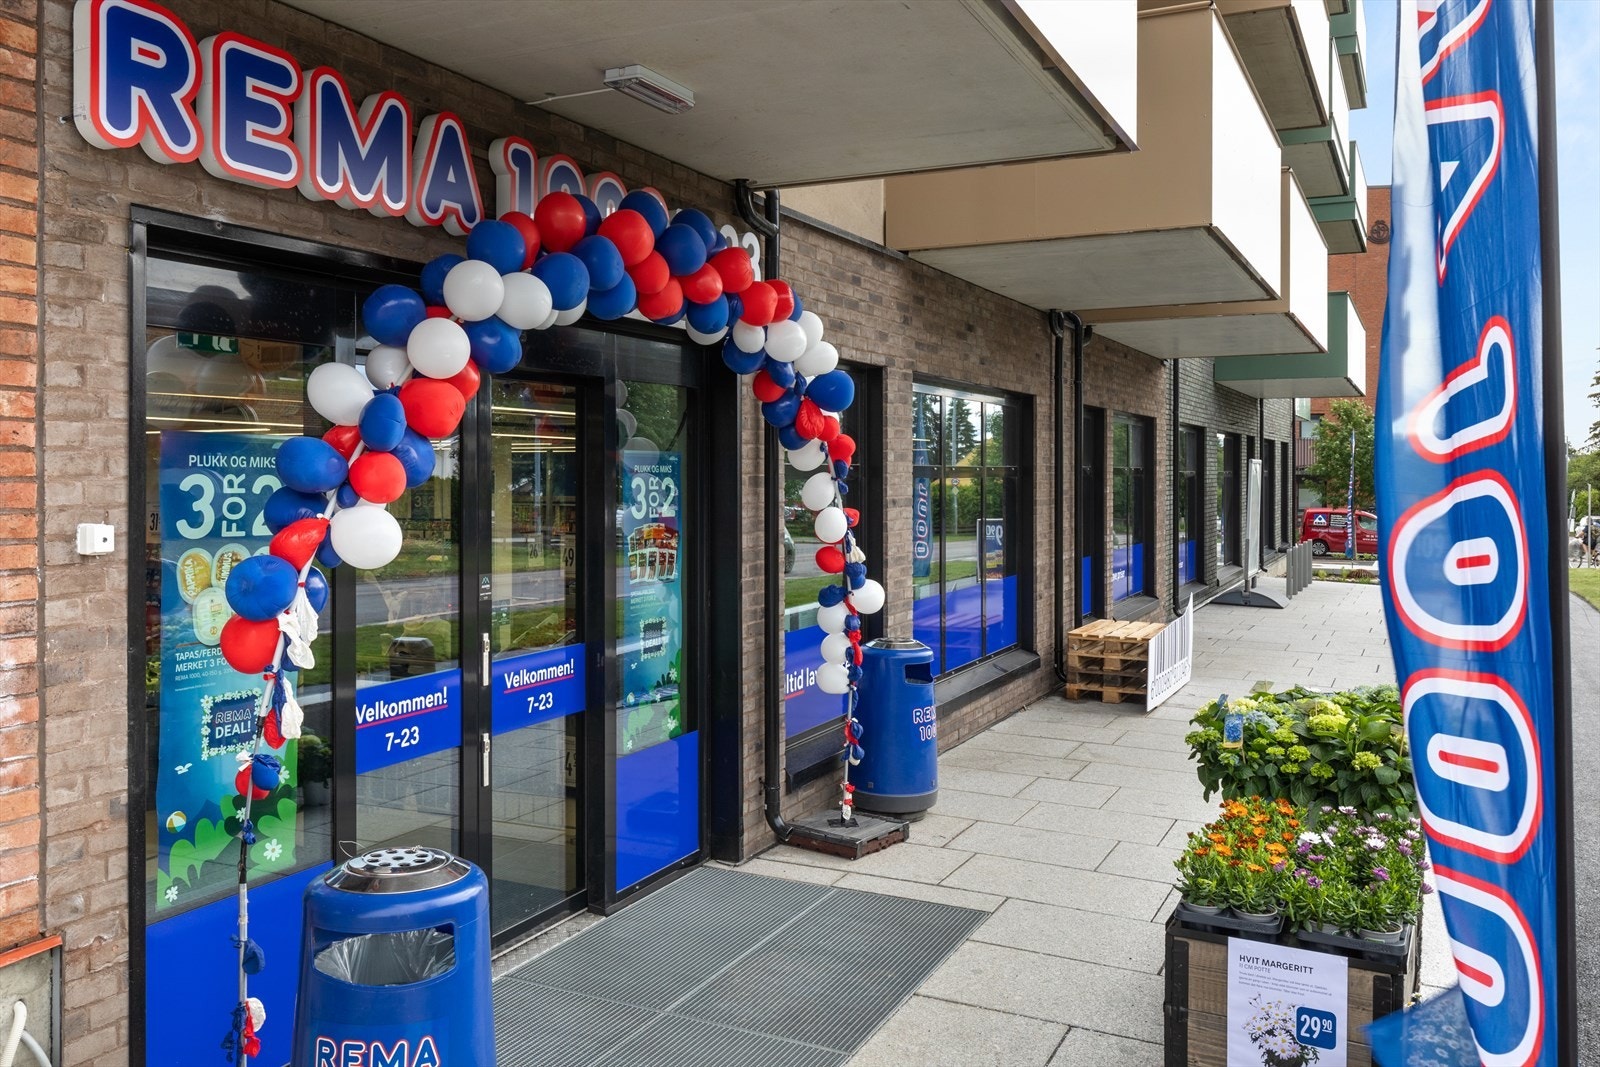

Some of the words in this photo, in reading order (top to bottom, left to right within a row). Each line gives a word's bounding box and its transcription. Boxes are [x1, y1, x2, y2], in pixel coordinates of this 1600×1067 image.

[90, 0, 485, 237] REMA
[188, 455, 228, 467] PLUKK
[230, 457, 247, 468] OG
[249, 457, 276, 469] MIKS
[176, 474, 215, 539] 3
[221, 474, 247, 538] FOR
[252, 475, 283, 536] 2
[630, 476, 647, 520] 3
[648, 476, 660, 518] FOR
[661, 476, 676, 517] 2
[562, 548, 574, 567] 49
[184, 557, 198, 597] PAPRIKA
[175, 648, 222, 661] TAPAS/FERD
[175, 660, 208, 673] MERKET
[210, 659, 215, 669] 3
[216, 658, 228, 668] FO
[503, 658, 574, 689] Velkommen!
[786, 669, 804, 694] ltid
[356, 686, 448, 725] Velkommen!
[527, 692, 554, 714] 7-23
[215, 708, 251, 724] REMA
[215, 721, 251, 739] DEAL!
[385, 726, 420, 751] 7-23
[1239, 954, 1260, 965] HVIT
[1261, 959, 1314, 975] MARGERITT
[1254, 965, 1271, 974] POTTE
[315, 1035, 441, 1067] REMA
